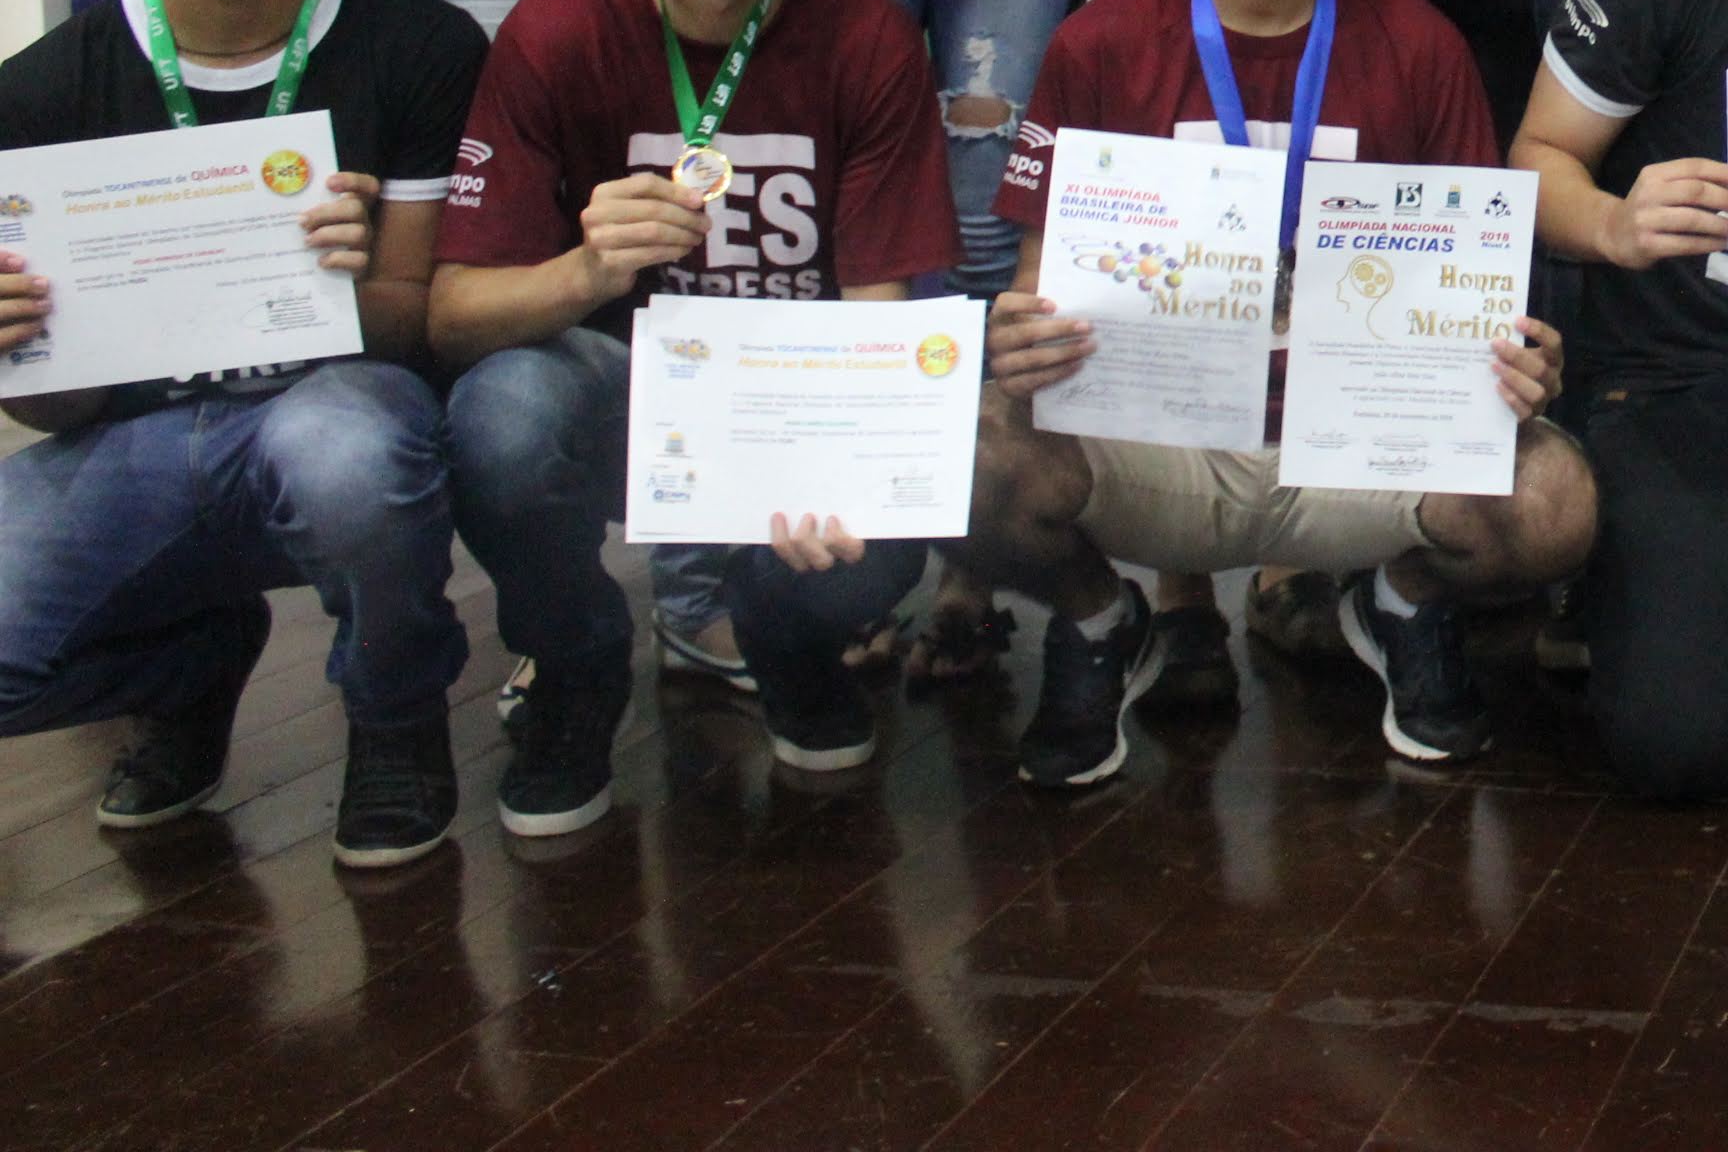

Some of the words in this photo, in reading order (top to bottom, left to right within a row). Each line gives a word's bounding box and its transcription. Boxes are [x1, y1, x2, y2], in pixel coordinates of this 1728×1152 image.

[191, 164, 249, 182] QUÍMICA
[1065, 183, 1081, 194] XI
[1083, 185, 1161, 202] OLIMPÍADA
[1059, 206, 1119, 223] QUÍMICA
[1060, 195, 1144, 214] BRASILEIRA
[1149, 205, 1169, 215] DE
[705, 173, 819, 268] ES
[1317, 219, 1388, 232] OLIMPÍADA
[1391, 222, 1457, 234] NACIONAL
[1316, 233, 1347, 249] DE
[1352, 232, 1456, 253] CIÊNCIAS
[1480, 231, 1510, 242] 2018
[1181, 239, 1264, 274] Honra
[662, 267, 822, 299] TRESS
[1229, 277, 1263, 297] ao
[1439, 263, 1515, 293] Honra
[1482, 296, 1514, 315] ao
[1405, 307, 1513, 341] Mérito
